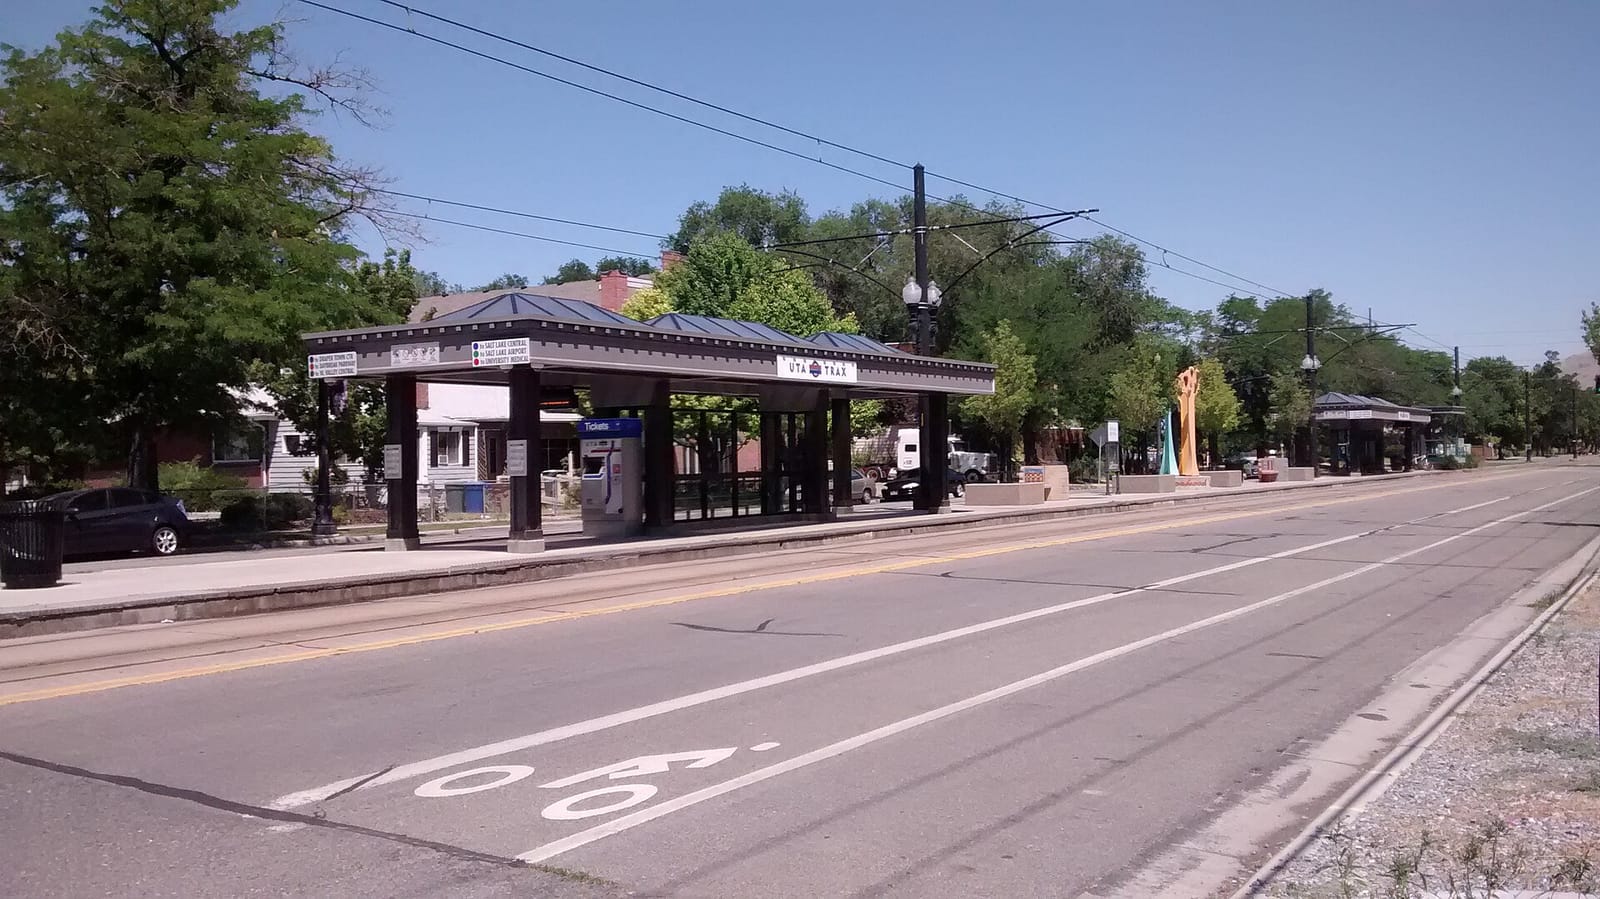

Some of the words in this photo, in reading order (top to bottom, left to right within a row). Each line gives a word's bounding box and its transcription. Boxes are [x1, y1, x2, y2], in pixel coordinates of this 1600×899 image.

[789, 362, 806, 373] UTA
[825, 366, 847, 377] TRAX
[584, 422, 609, 431] Tickets
